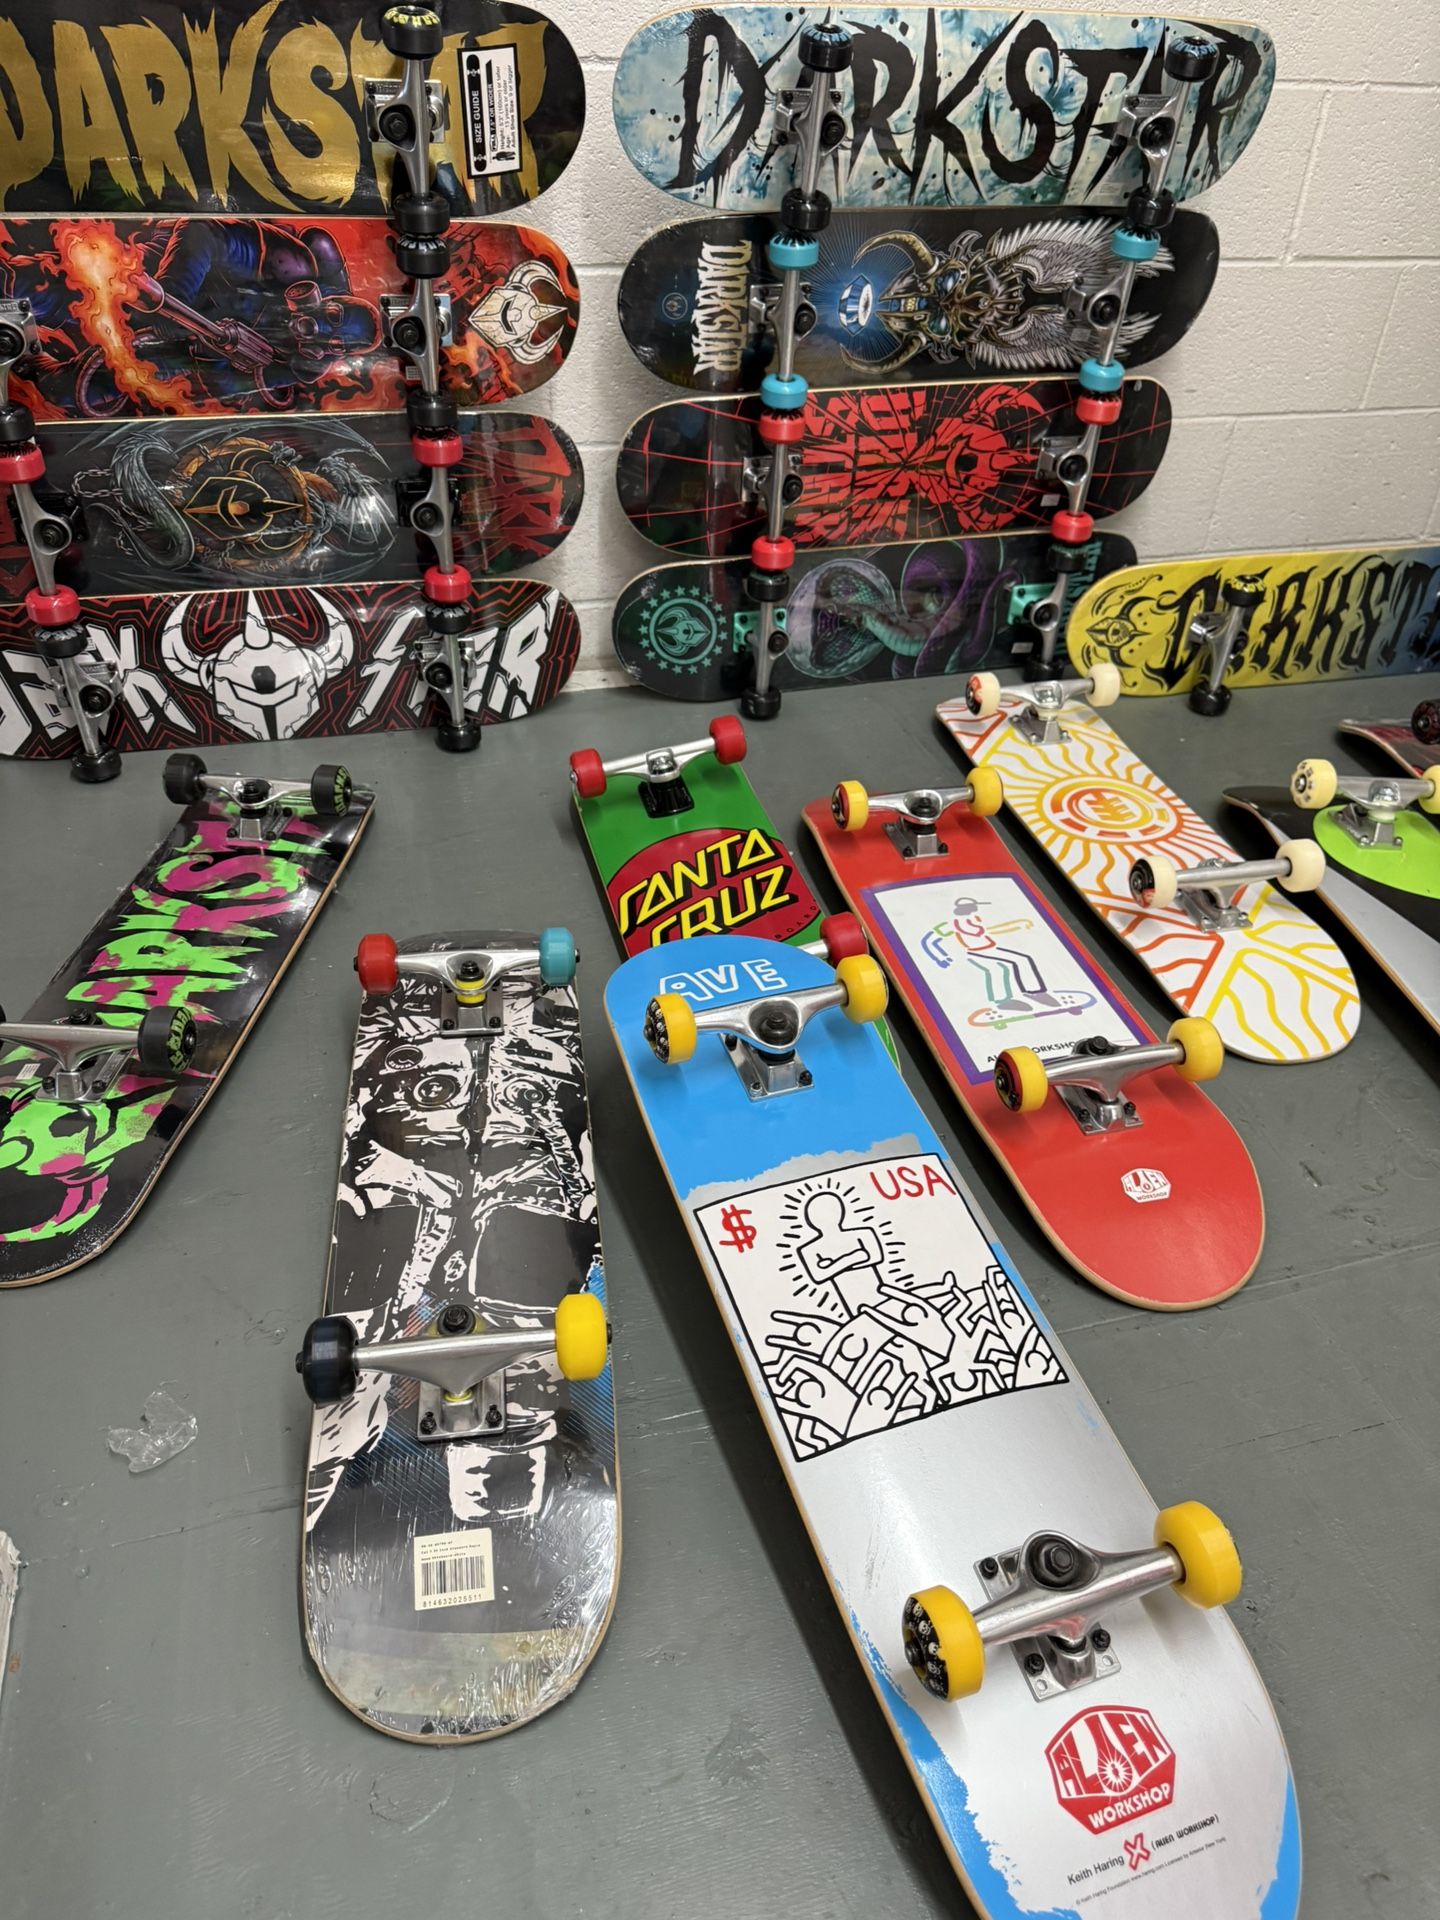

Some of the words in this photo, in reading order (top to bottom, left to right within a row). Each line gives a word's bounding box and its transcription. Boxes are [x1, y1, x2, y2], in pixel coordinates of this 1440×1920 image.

[472, 90, 481, 120] GUIDE
[474, 123, 483, 143] SIZE
[690, 239, 752, 376] DARKSTAR
[619, 828, 777, 936] SANTA
[651, 865, 792, 947] CRUZ
[658, 958, 787, 1002] AVE
[869, 1164, 956, 1200] USA
[719, 1204, 757, 1252] $
[1051, 1712, 1170, 1798] ALIEN
[1088, 1782, 1171, 1829] WORKSHOP
[1067, 1867, 1093, 1885] Keith
[1093, 1854, 1125, 1874] Haring
